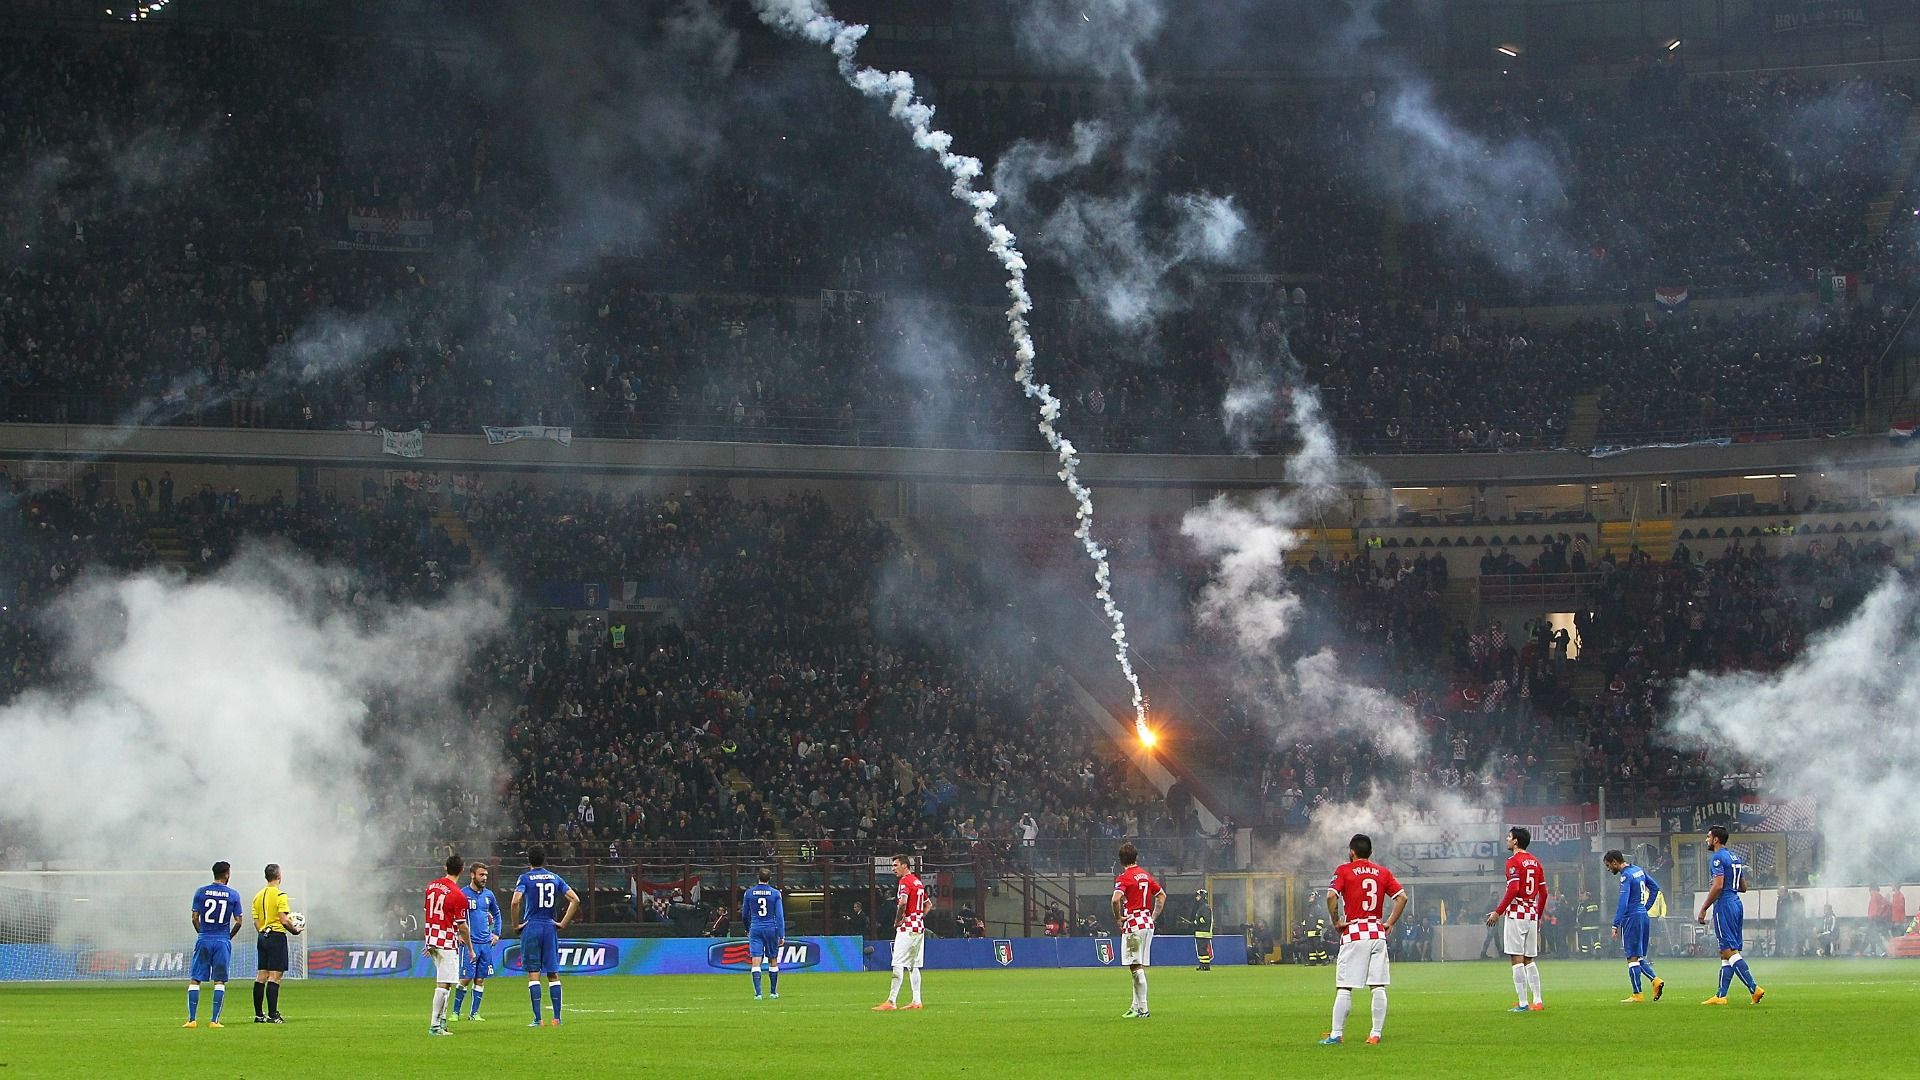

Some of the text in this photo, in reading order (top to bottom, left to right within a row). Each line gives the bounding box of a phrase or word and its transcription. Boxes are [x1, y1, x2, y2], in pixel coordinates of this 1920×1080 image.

[1525, 869, 1535, 895] 5
[1731, 863, 1742, 890] 17
[468, 899, 477, 910] 16
[536, 882, 555, 908] 13
[1138, 881, 1149, 907] 7
[1362, 878, 1378, 912] 3
[1639, 880, 1646, 905] 8
[204, 898, 228, 924] 21
[427, 891, 446, 921] 14
[757, 897, 767, 917] 3
[134, 952, 184, 971] TIM
[349, 950, 398, 969] TIM
[557, 948, 606, 966] TIM
